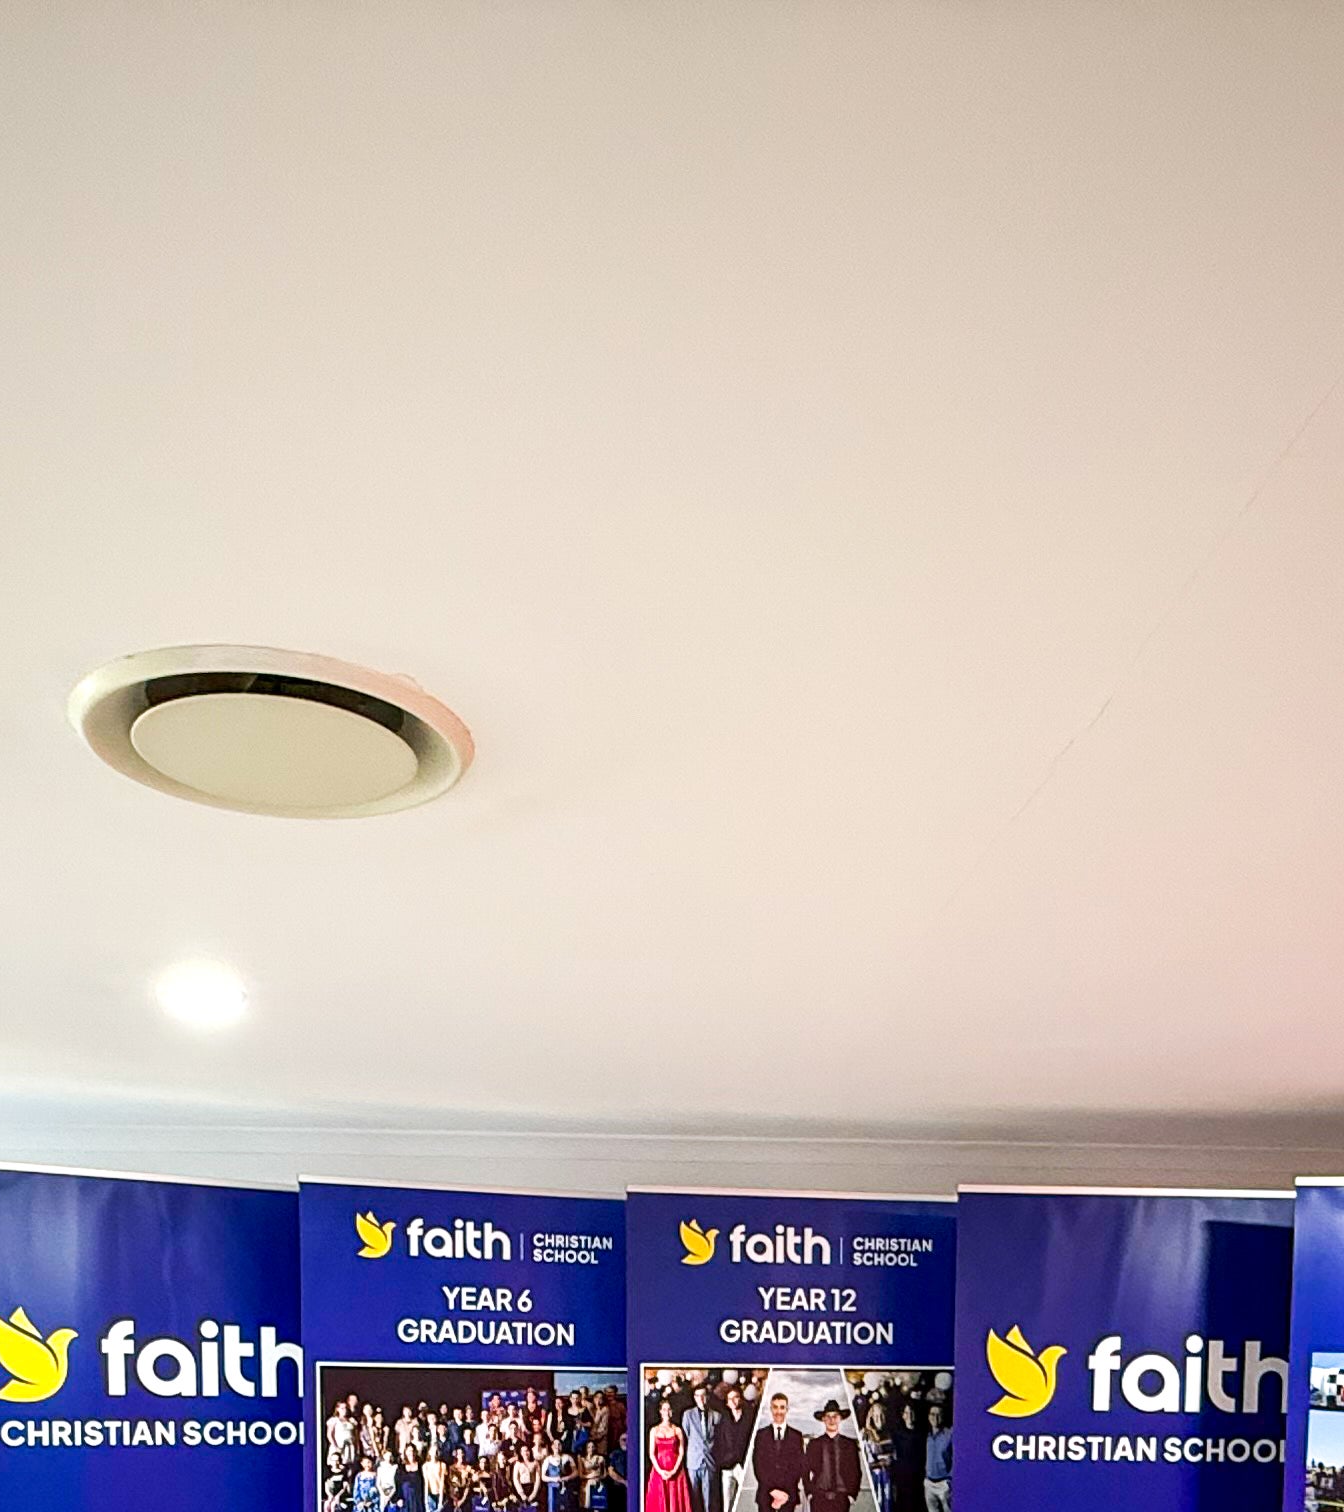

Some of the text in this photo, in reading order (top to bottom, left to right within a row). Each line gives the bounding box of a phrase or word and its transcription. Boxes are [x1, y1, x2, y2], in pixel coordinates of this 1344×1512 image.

[406, 1217, 512, 1261] faith
[532, 1232, 613, 1251] CHRISTIAN
[729, 1224, 831, 1265] faith
[852, 1236, 934, 1252] CHRISTIAN
[532, 1248, 600, 1265] SCHOOL
[852, 1252, 919, 1267] SCHOOL
[442, 1286, 533, 1313] YEAR 6
[757, 1286, 857, 1312] YEAR 12
[397, 1318, 575, 1346] GRADUATION
[719, 1319, 894, 1345] GRADUATION
[101, 1319, 304, 1398] faith
[1087, 1334, 1289, 1413] faith
[0, 1420, 176, 1447] CHRISTIAN
[992, 1434, 1157, 1462] CHRISTIAN
